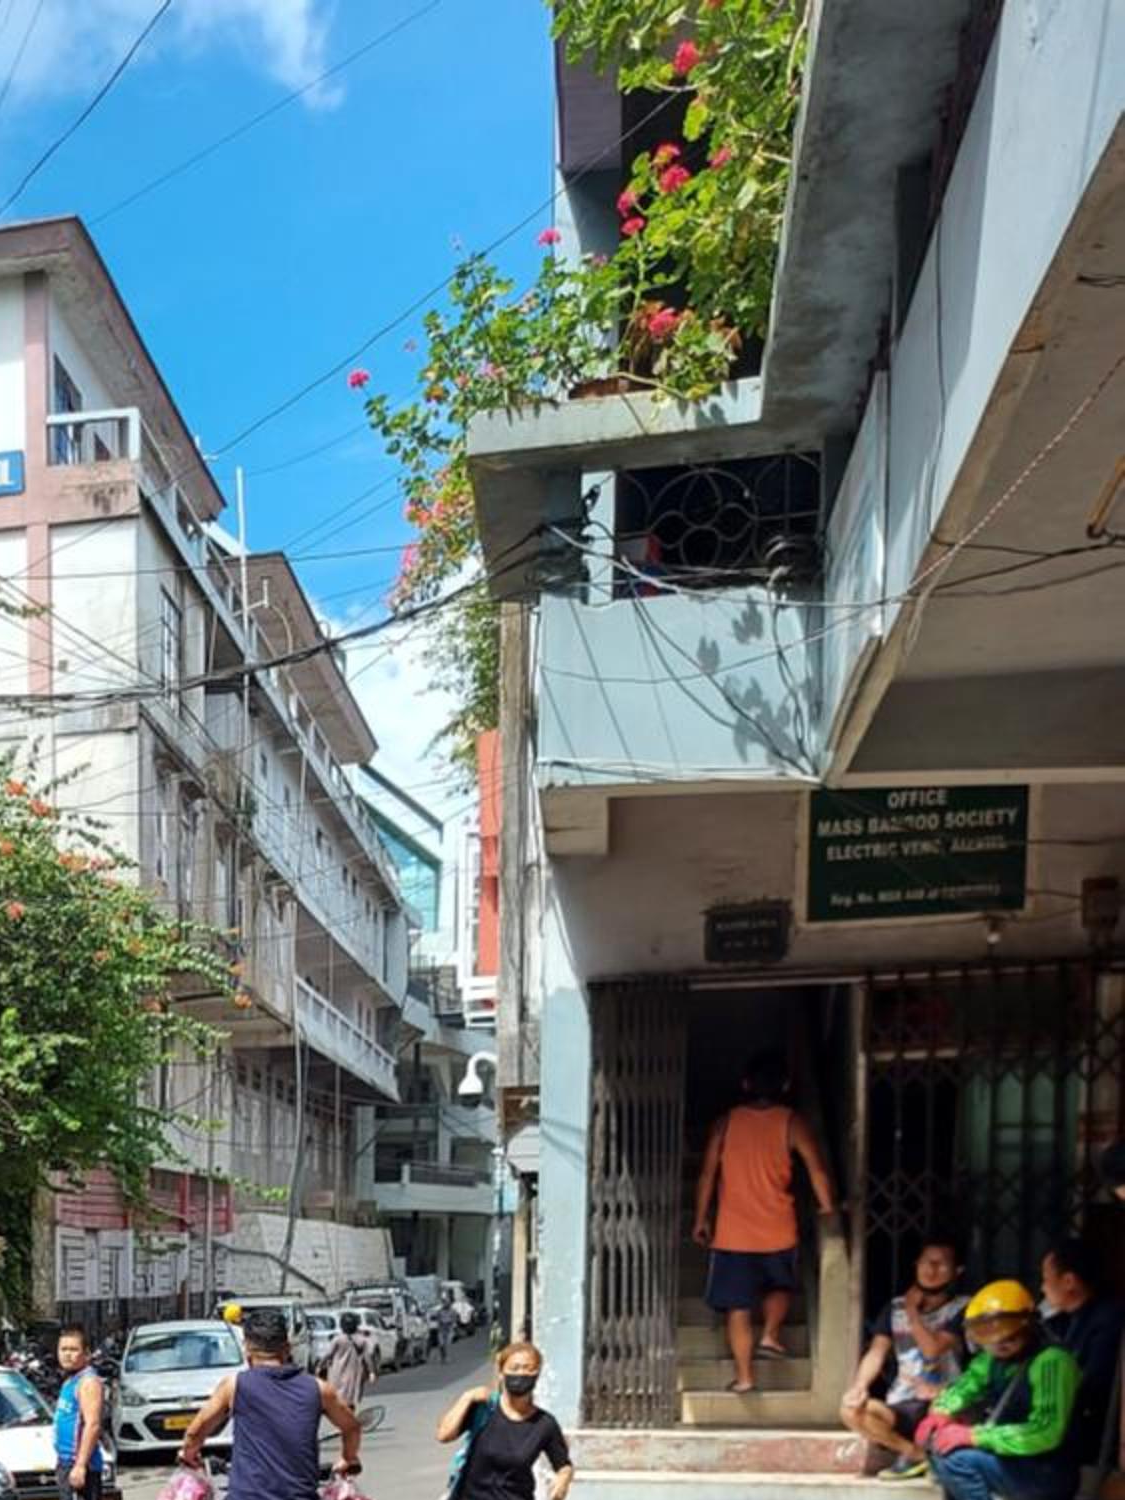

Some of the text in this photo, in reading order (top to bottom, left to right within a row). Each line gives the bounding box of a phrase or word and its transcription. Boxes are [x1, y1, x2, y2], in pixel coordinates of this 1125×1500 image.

[887, 789, 949, 809] OFFICE
[817, 818, 863, 837] MASS
[944, 807, 1018, 829] SOCIETY
